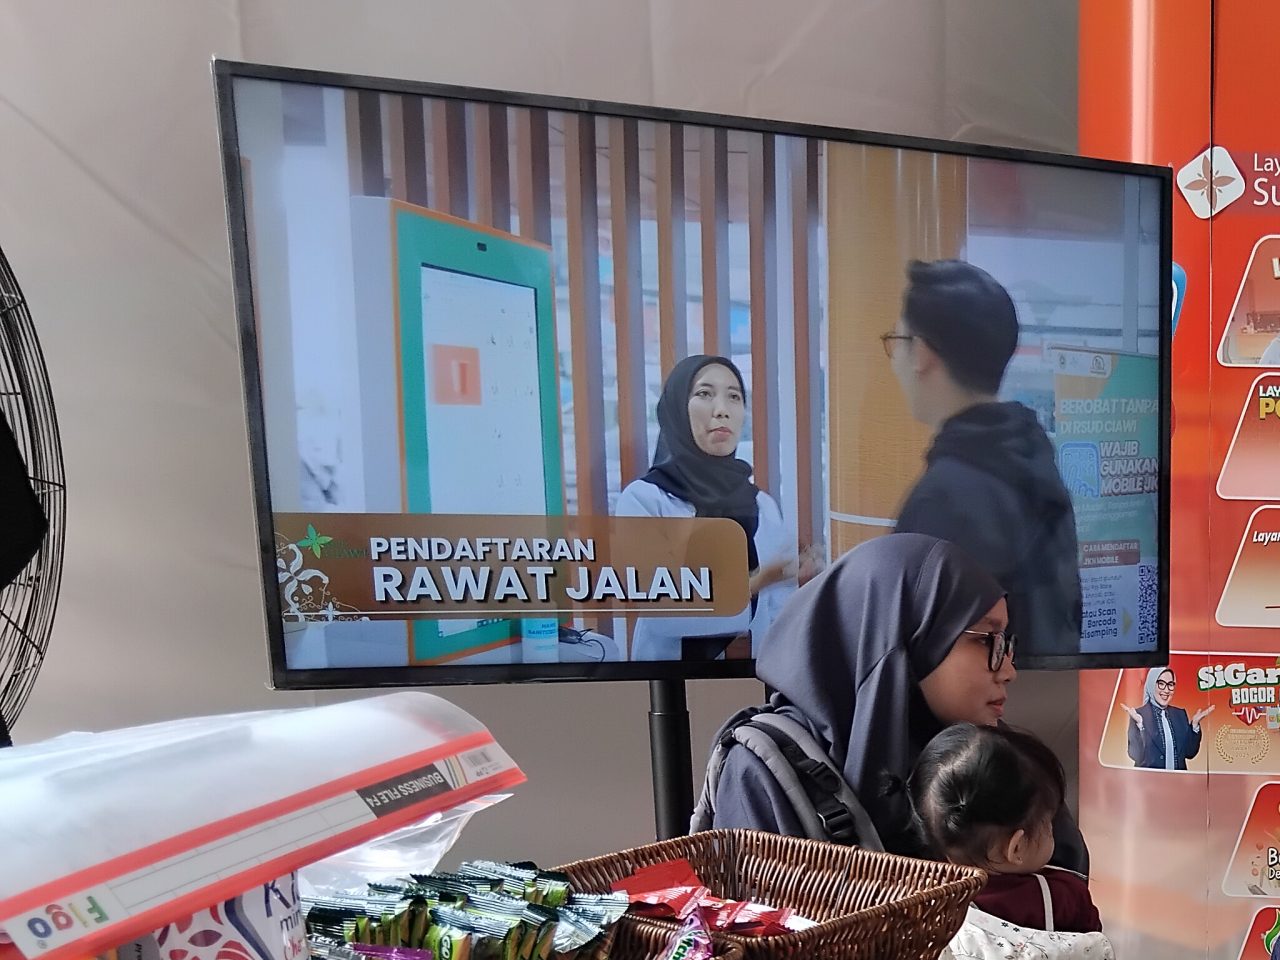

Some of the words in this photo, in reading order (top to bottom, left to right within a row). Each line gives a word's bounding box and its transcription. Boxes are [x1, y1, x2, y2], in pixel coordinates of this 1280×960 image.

[1060, 400, 1118, 414] BEROBAT
[1120, 399, 1158, 414] TANPA
[1060, 421, 1071, 433] DI
[1073, 420, 1104, 433] RSUD
[1105, 420, 1136, 432] CIAWI
[1100, 441, 1138, 457] WAJIB
[1100, 458, 1158, 475] GUNAKAN
[1100, 478, 1140, 496] MOBILE
[370, 537, 595, 561] PENDAFTARAN
[373, 566, 554, 602] RAWAT
[566, 566, 711, 601] JALAN
[1098, 608, 1116, 617] Scan
[1087, 617, 1116, 629] Barcode
[1232, 688, 1274, 705] BOGOR
[400, 771, 444, 796] BUSINESS
[365, 795, 381, 808] F4
[379, 788, 401, 803] FILE
